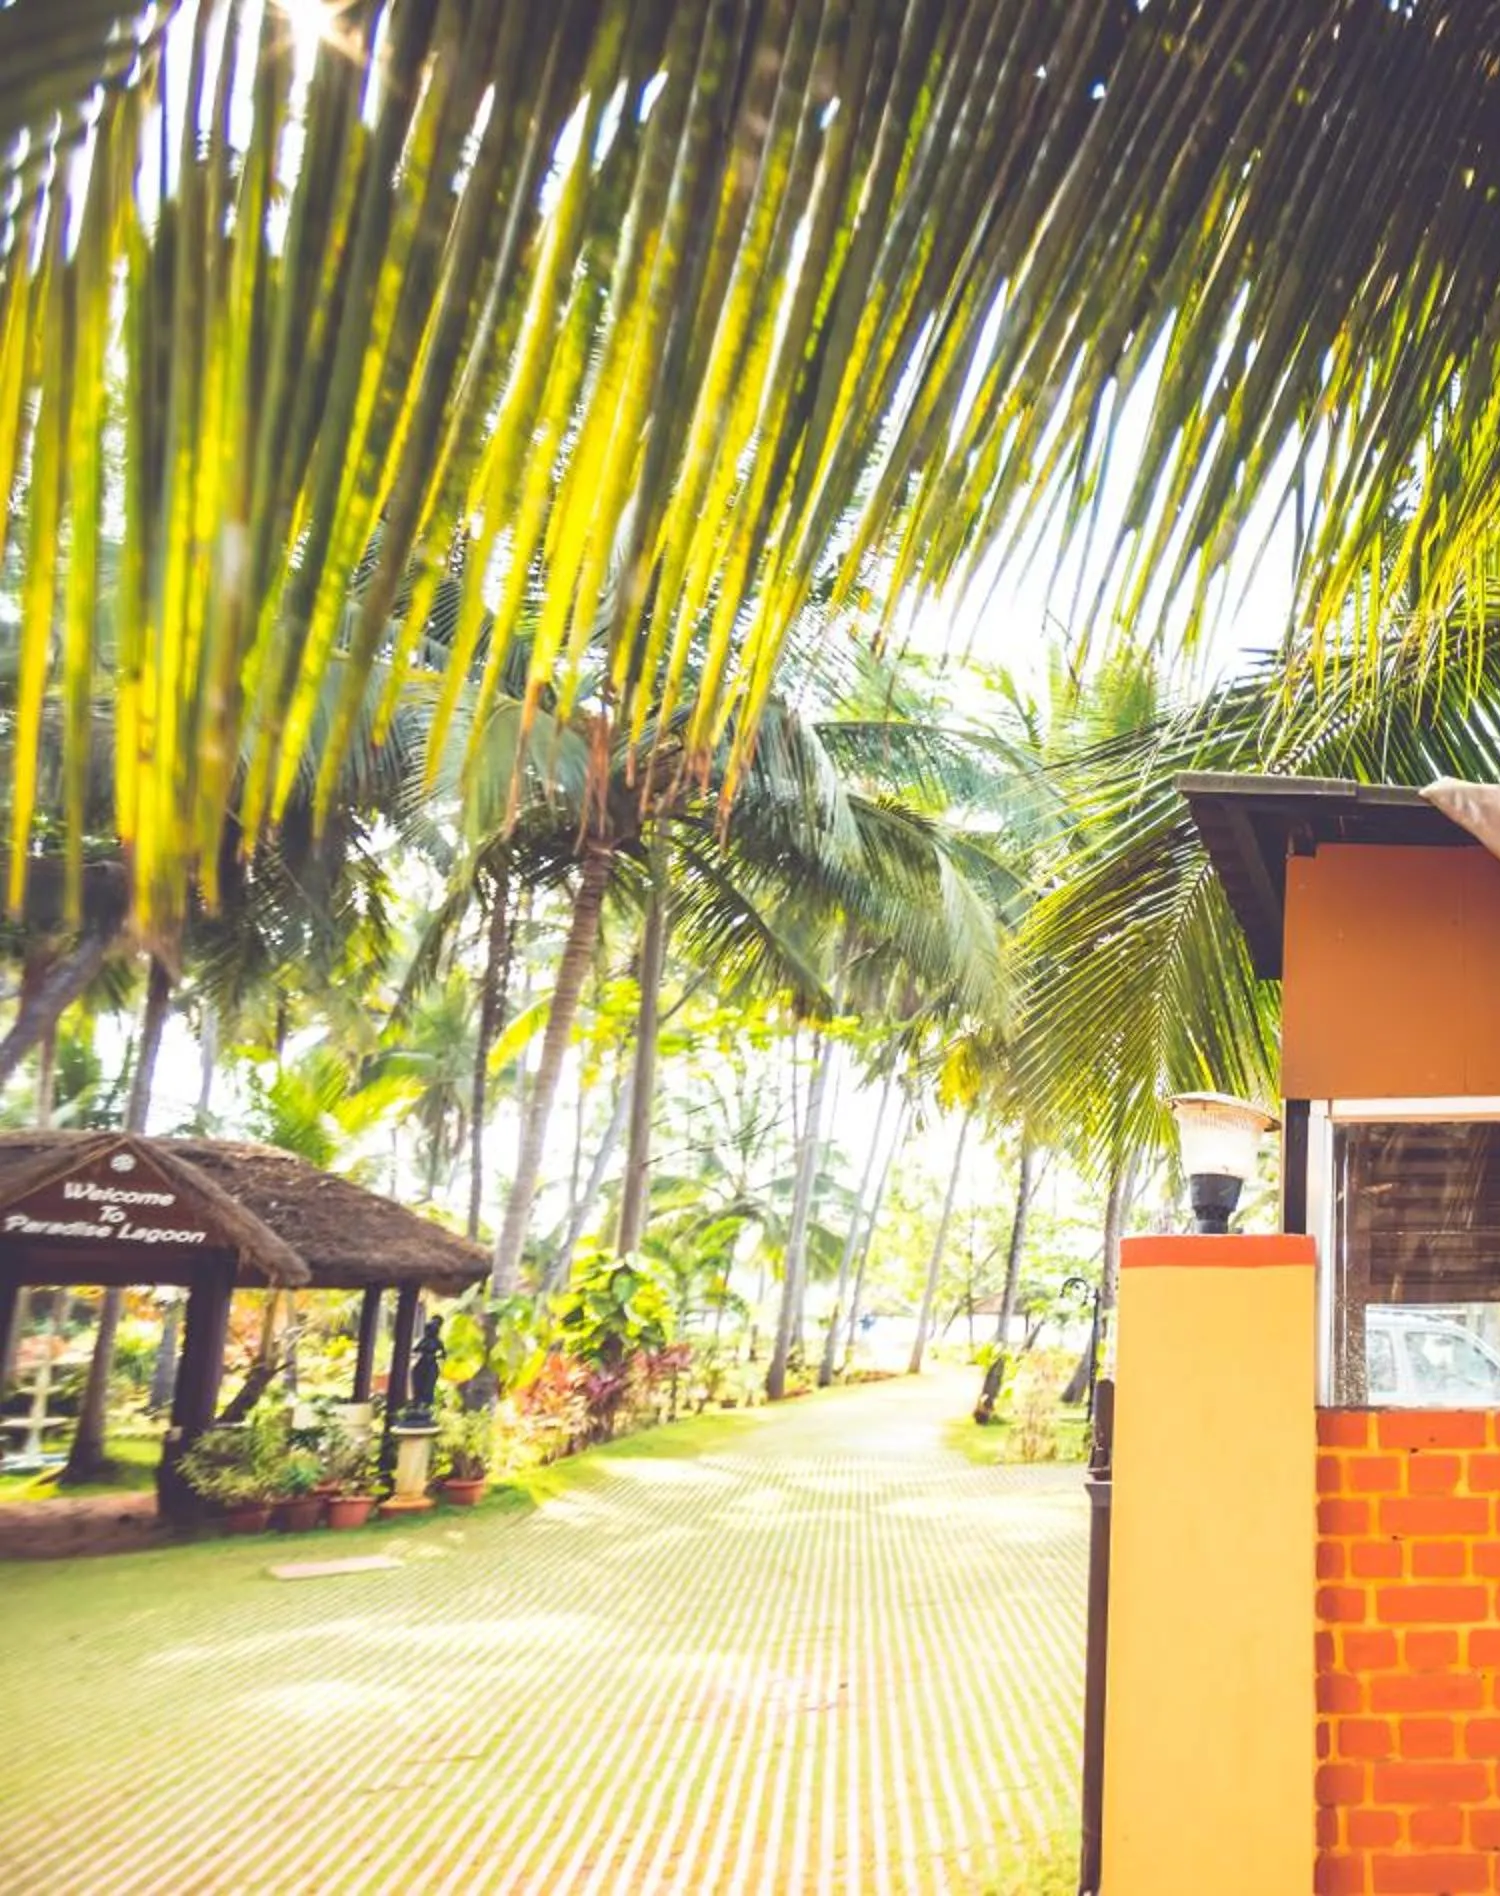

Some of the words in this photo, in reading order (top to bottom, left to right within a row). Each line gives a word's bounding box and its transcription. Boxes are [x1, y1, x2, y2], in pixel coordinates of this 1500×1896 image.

[63, 1181, 175, 1207] Welcome
[100, 1205, 126, 1223] To
[4, 1213, 112, 1238] Paradise
[117, 1222, 206, 1244] Lagoon
